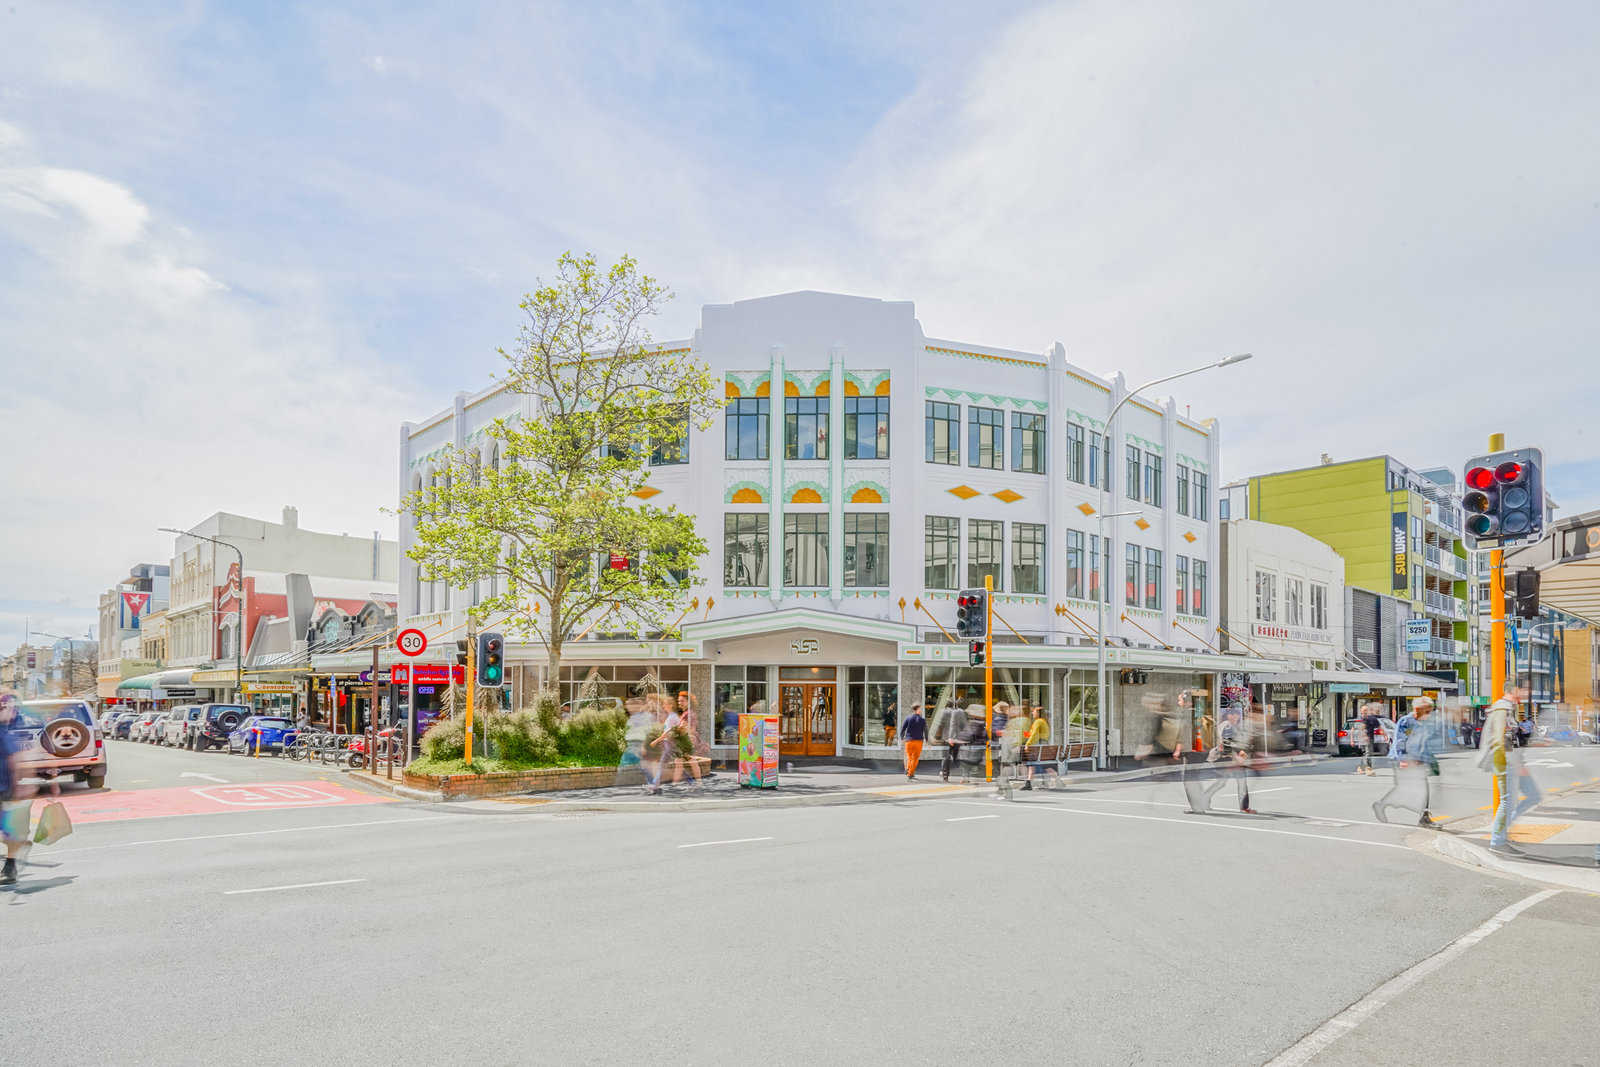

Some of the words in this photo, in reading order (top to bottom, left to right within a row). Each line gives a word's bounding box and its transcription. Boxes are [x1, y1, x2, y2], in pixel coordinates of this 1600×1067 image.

[1394, 526, 1407, 576] SUBWAY
[1410, 626, 1428, 634] $250
[404, 636, 421, 648] 30
[221, 787, 313, 801] 30
